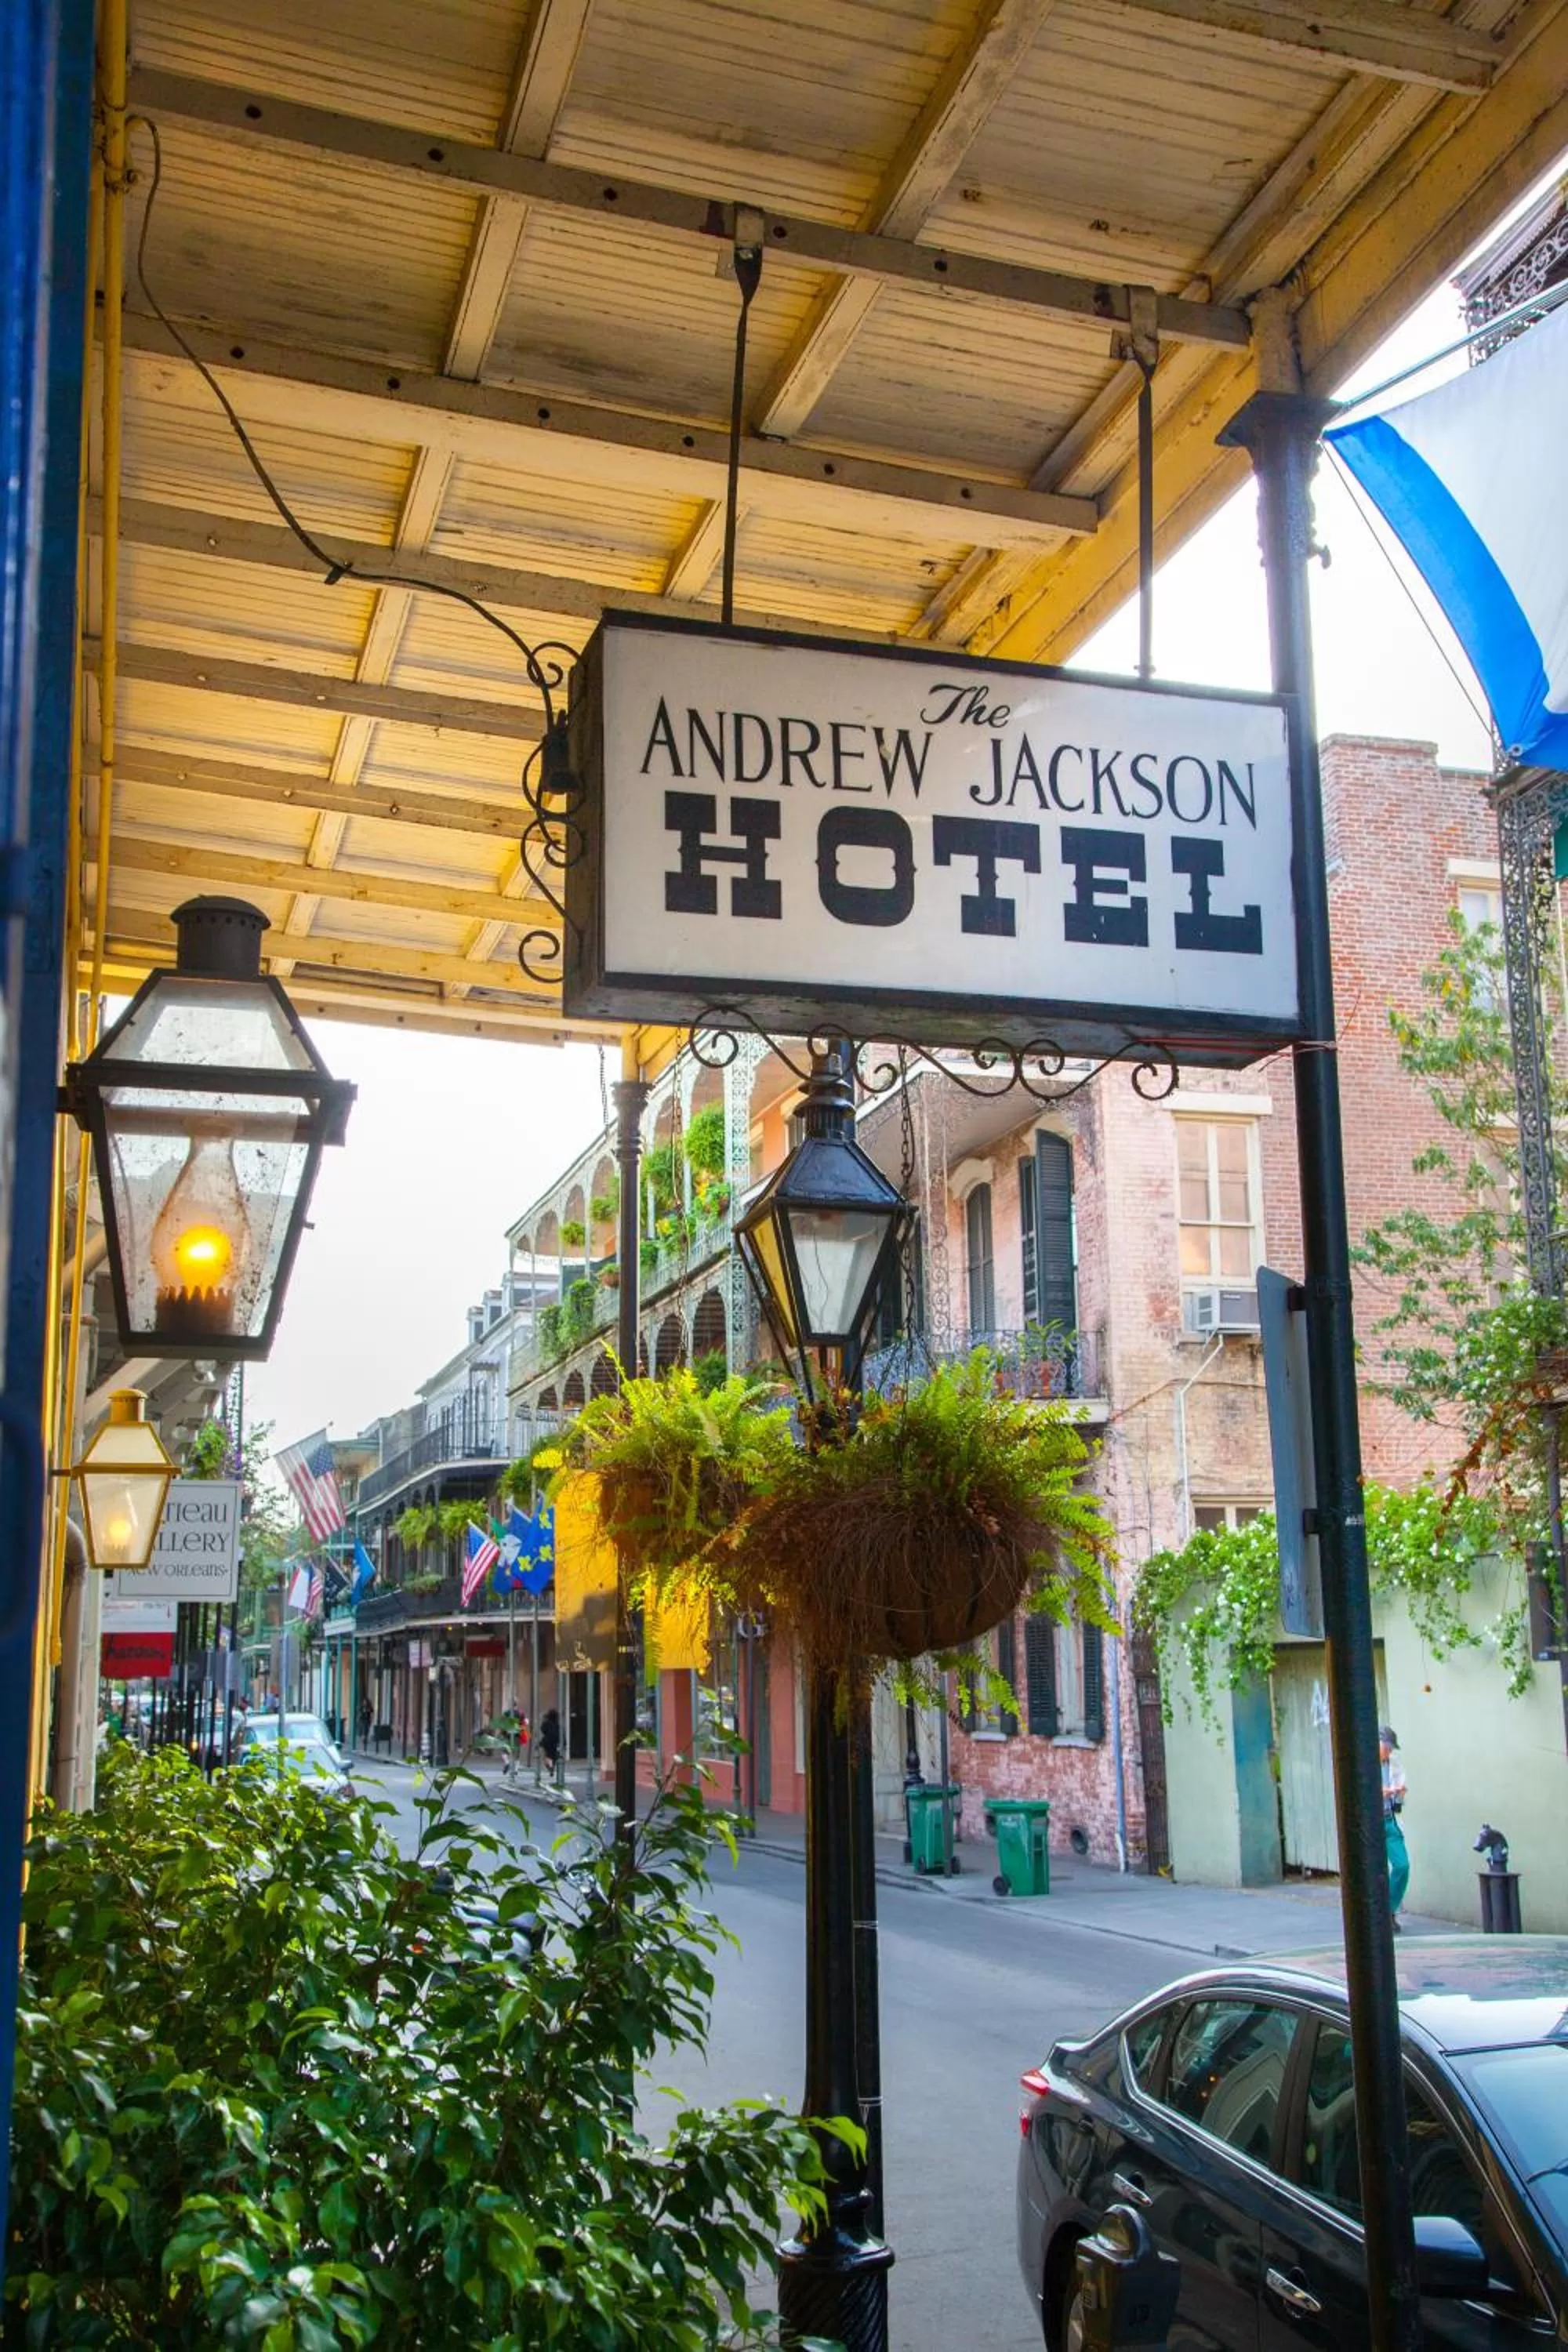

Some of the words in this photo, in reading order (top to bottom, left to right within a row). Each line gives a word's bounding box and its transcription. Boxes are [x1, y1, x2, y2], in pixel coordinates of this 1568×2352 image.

[641, 695, 934, 800] ANDREW
[970, 732, 1256, 831] JACKSON
[920, 684, 1010, 728] The
[665, 790, 1263, 955] HOTEL
